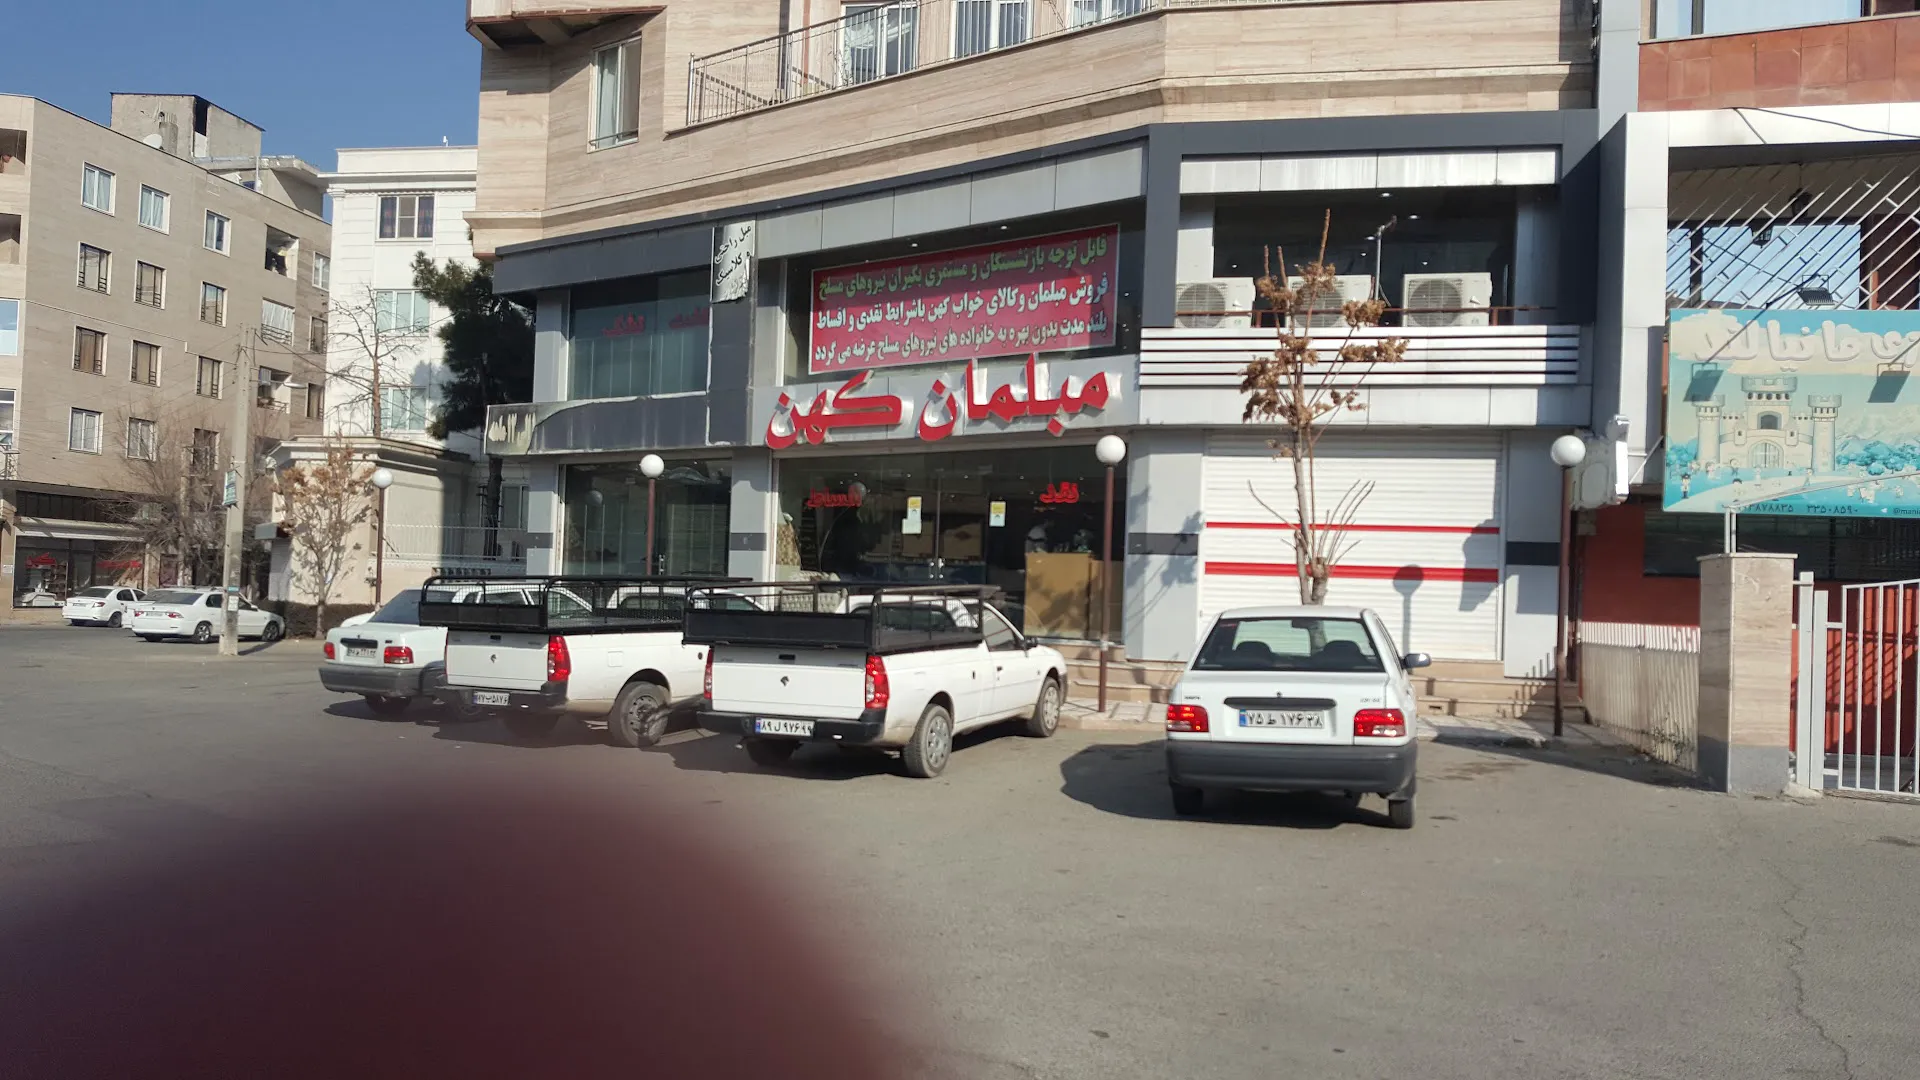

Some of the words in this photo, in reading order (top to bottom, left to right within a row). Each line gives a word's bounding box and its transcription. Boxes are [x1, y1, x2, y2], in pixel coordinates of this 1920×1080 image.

[738, 225, 752, 243] مبل
[1048, 239, 1077, 268] توجه
[1080, 233, 1107, 265] قابل
[716, 252, 742, 286] کلاسیک
[971, 263, 978, 281] و
[818, 276, 844, 300] مسلح
[846, 269, 887, 298] نیروهای
[1027, 279, 1067, 311] مبلمان
[1069, 271, 1108, 305] فروش
[856, 303, 883, 330] نقدی
[927, 296, 950, 322] کهن
[952, 290, 984, 318] خواب
[816, 306, 846, 329] اقساط
[848, 313, 854, 332] و
[1059, 317, 1085, 335] مدت
[1086, 310, 1108, 336] بلند
[901, 330, 937, 358] نیروهای
[938, 327, 958, 353] های
[959, 323, 995, 352] خانواده
[997, 329, 1007, 347] به
[1009, 324, 1030, 347] بهره
[1031, 320, 1058, 345] بدون
[837, 345, 852, 364] می
[852, 338, 876, 361] عرضه
[877, 335, 900, 360] مسلح
[765, 370, 904, 449] کهن
[917, 352, 1111, 442] مبلمان
[1040, 482, 1079, 503] نقد
[1893, 507, 1920, 516] @mani
